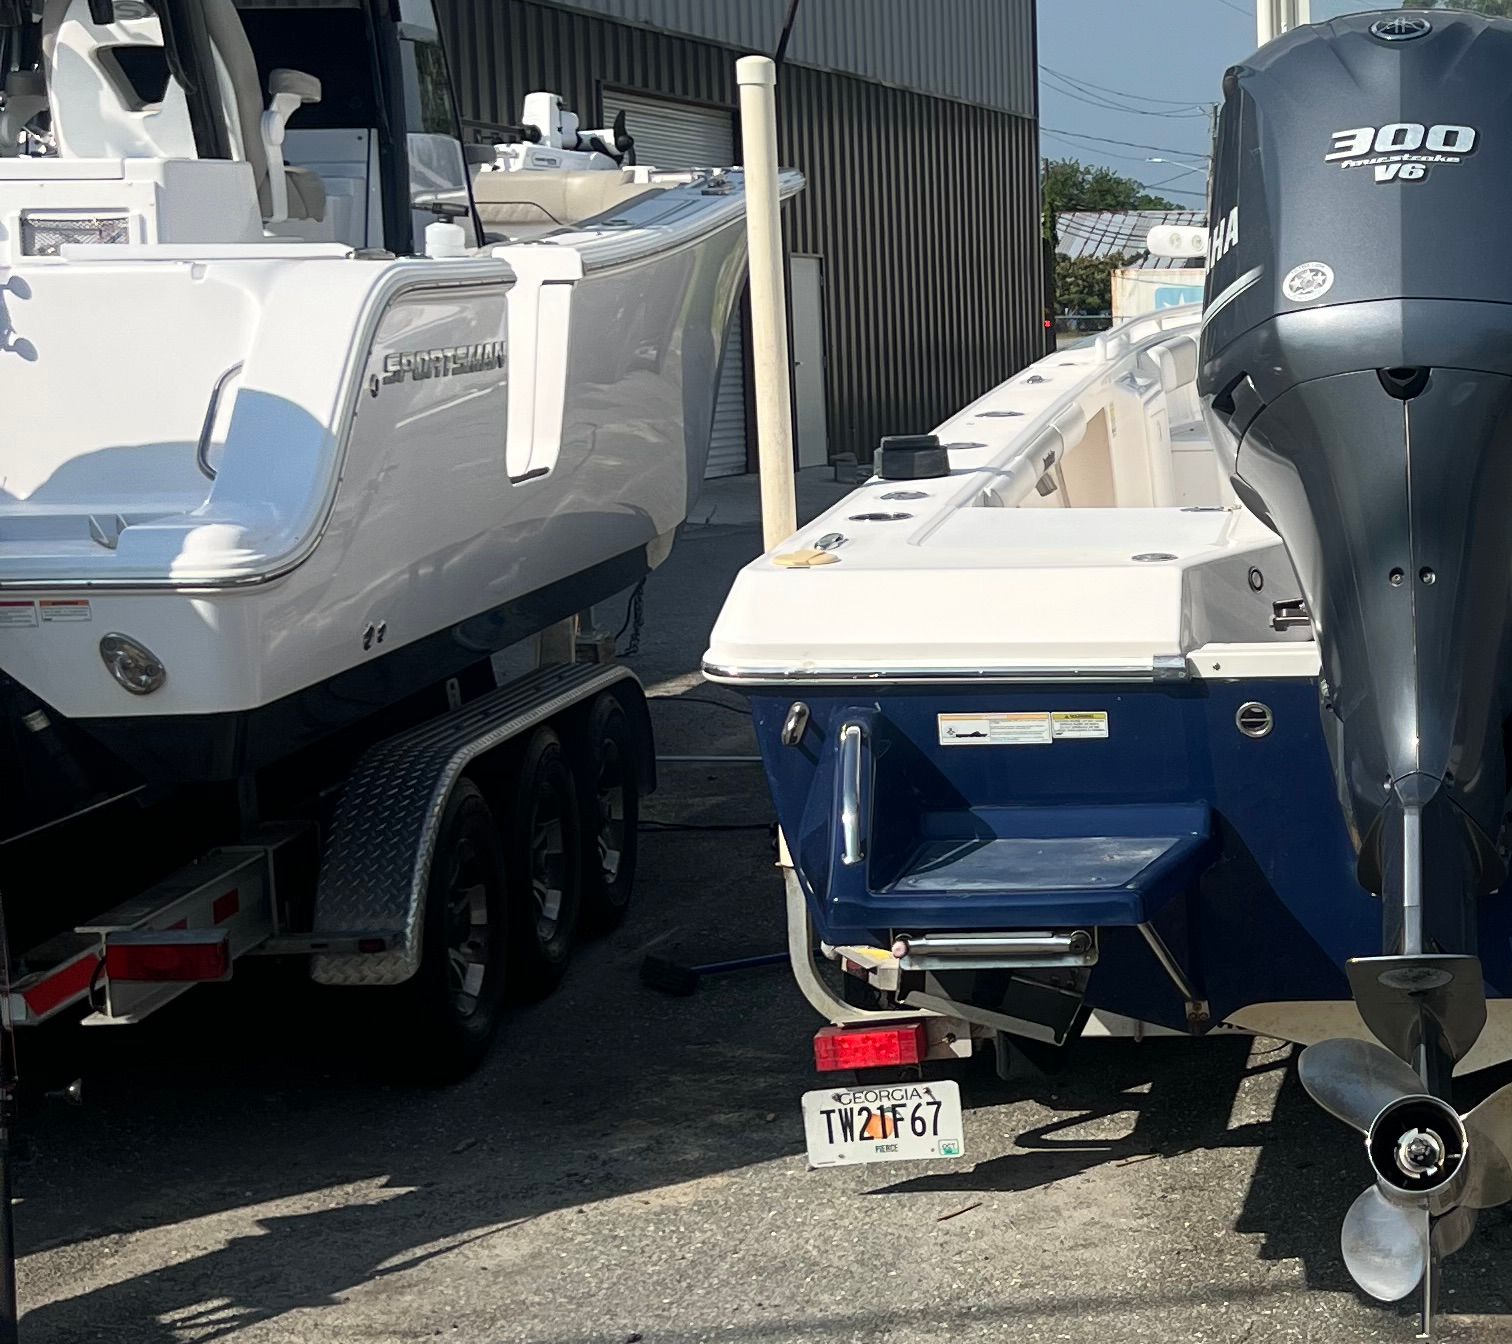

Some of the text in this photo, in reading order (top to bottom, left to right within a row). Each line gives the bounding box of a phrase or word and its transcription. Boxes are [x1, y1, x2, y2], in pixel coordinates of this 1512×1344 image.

[1325, 123, 1476, 161] 300
[1374, 163, 1426, 182] V6
[382, 340, 507, 386] SPORTSMAN
[839, 1087, 923, 1106] GEORGIA
[819, 1100, 942, 1144] TW21F67
